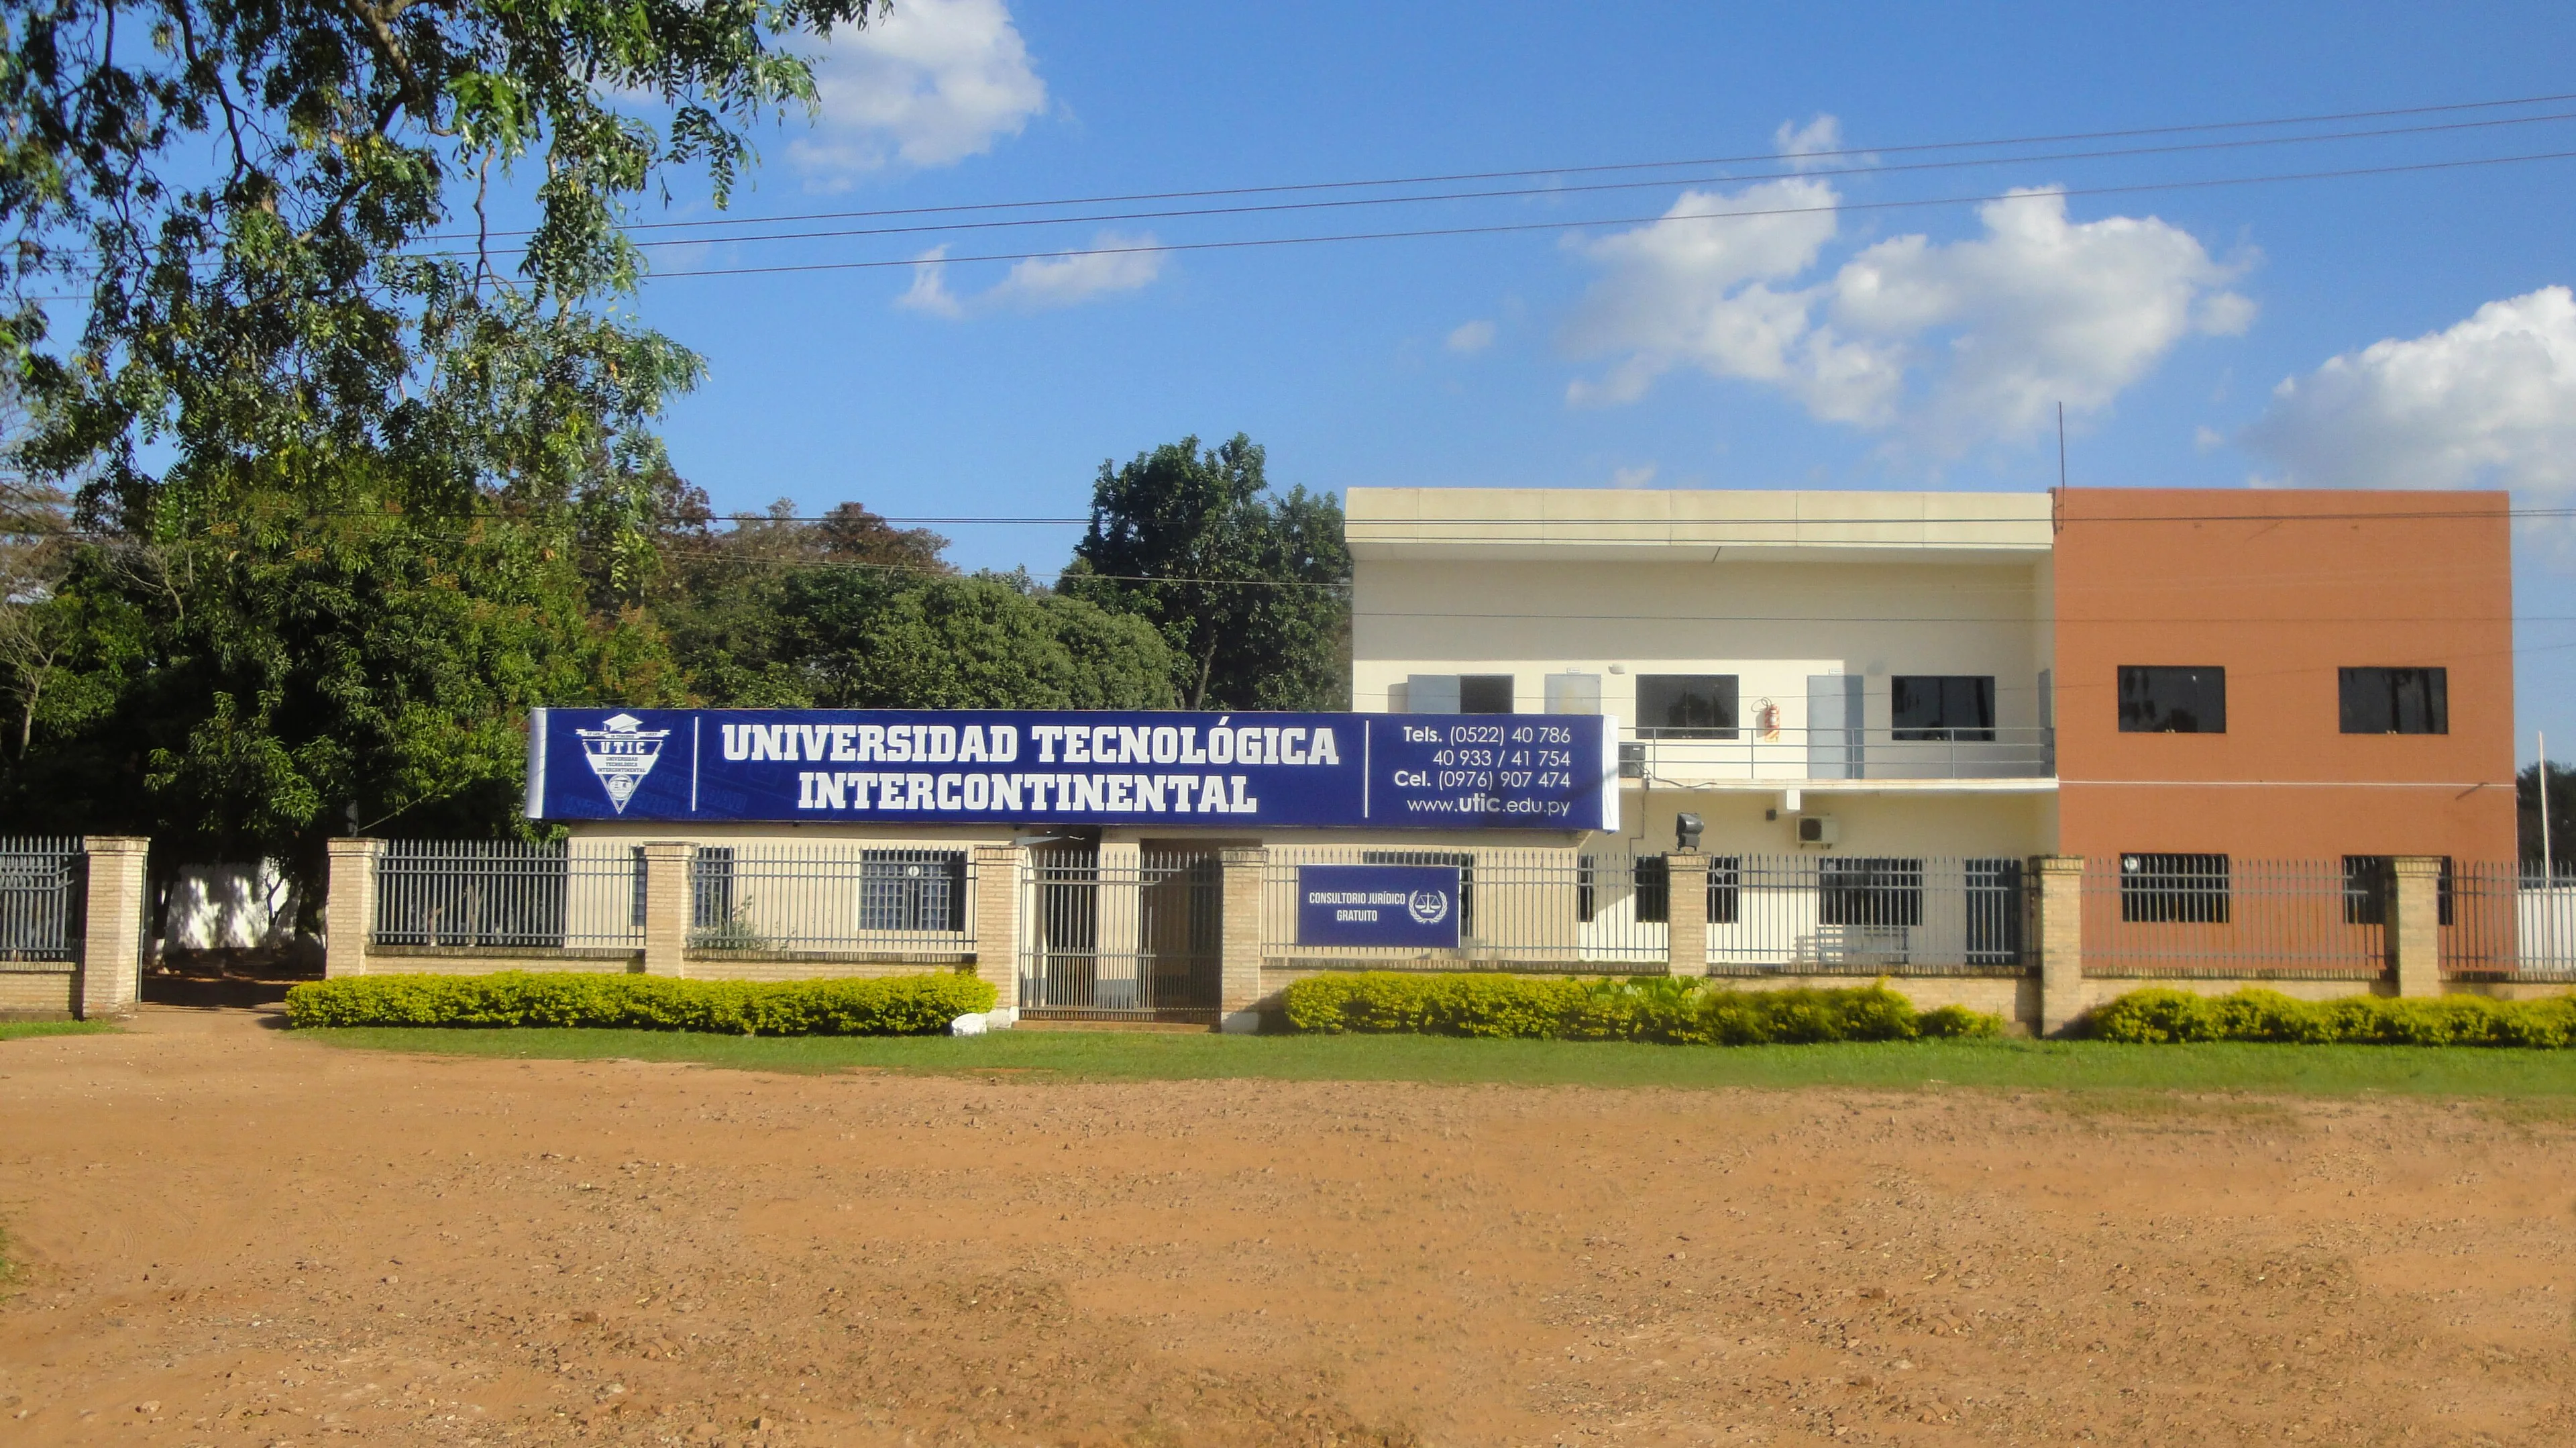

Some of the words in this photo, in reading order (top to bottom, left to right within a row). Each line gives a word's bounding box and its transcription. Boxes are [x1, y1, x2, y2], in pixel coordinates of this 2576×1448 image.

[722, 724, 1018, 762] UNIVERSIDAD
[1032, 716, 1340, 765] TECNOLÓGICA
[1403, 726, 1442, 743] Tels.
[1450, 726, 1504, 746] (0522)
[1511, 727, 1534, 743] 40
[1539, 727, 1571, 743] 786
[600, 741, 645, 754] UTIC
[1432, 750, 1454, 766] 40
[1460, 750, 1492, 766] 933
[1497, 750, 1506, 768] /
[1511, 751, 1529, 766] 41
[1538, 751, 1571, 767] 754
[1394, 770, 1432, 787] Cel.
[1438, 771, 1493, 790] (0976)
[1500, 772, 1533, 788] 907
[1538, 772, 1571, 788] 474
[798, 772, 1257, 813] INTERCONTINENTAL
[1407, 792, 1571, 816] www.utic.edu.py
[1309, 892, 1366, 904] CONSULTORIO
[1367, 890, 1406, 905] JURÍDICO
[1336, 909, 1378, 922] GRATUITO
